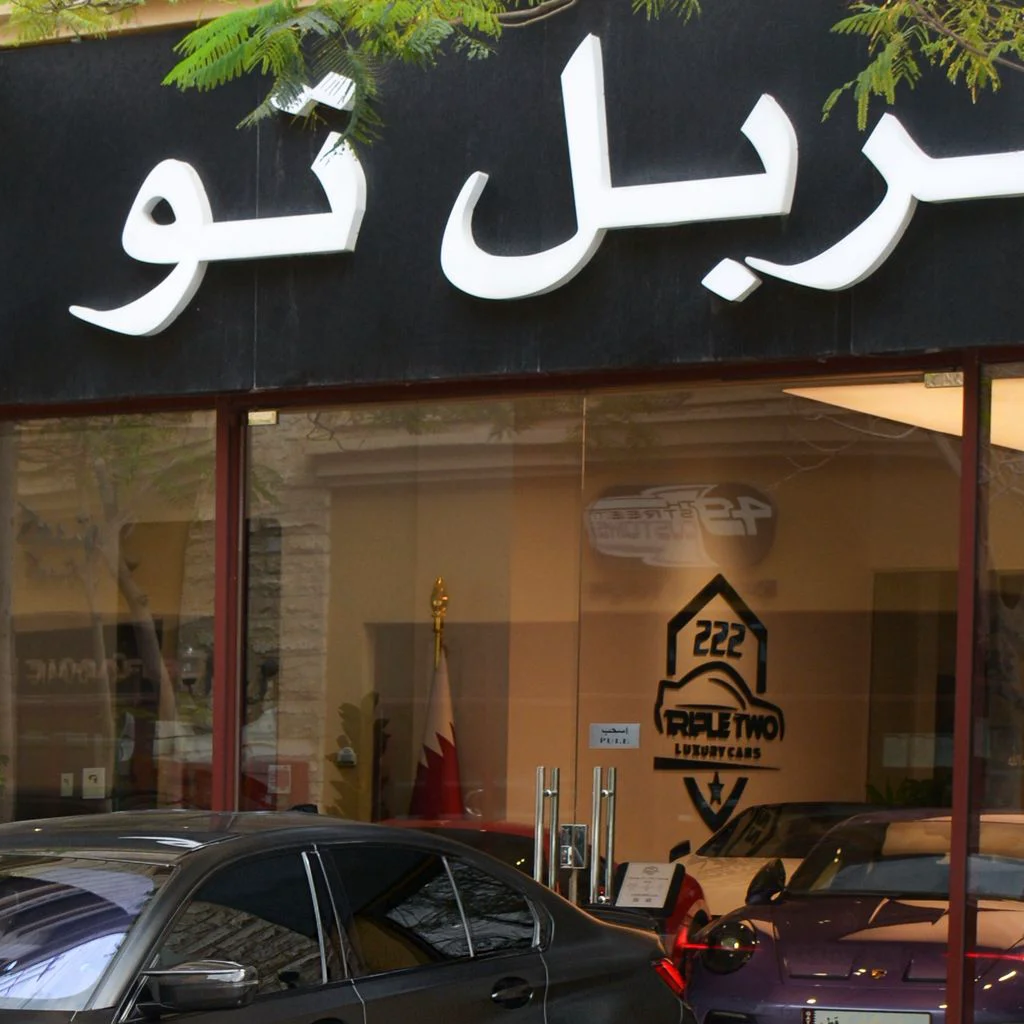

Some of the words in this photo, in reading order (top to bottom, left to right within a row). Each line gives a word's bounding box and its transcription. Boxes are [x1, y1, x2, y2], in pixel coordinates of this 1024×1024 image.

[440, 32, 1024, 303] ربل
[693, 620, 746, 658] 222
[664, 709, 731, 739] TRIPLE
[733, 713, 779, 741] TWO
[675, 743, 726, 757] LUXURY
[728, 747, 761, 760] CARS
